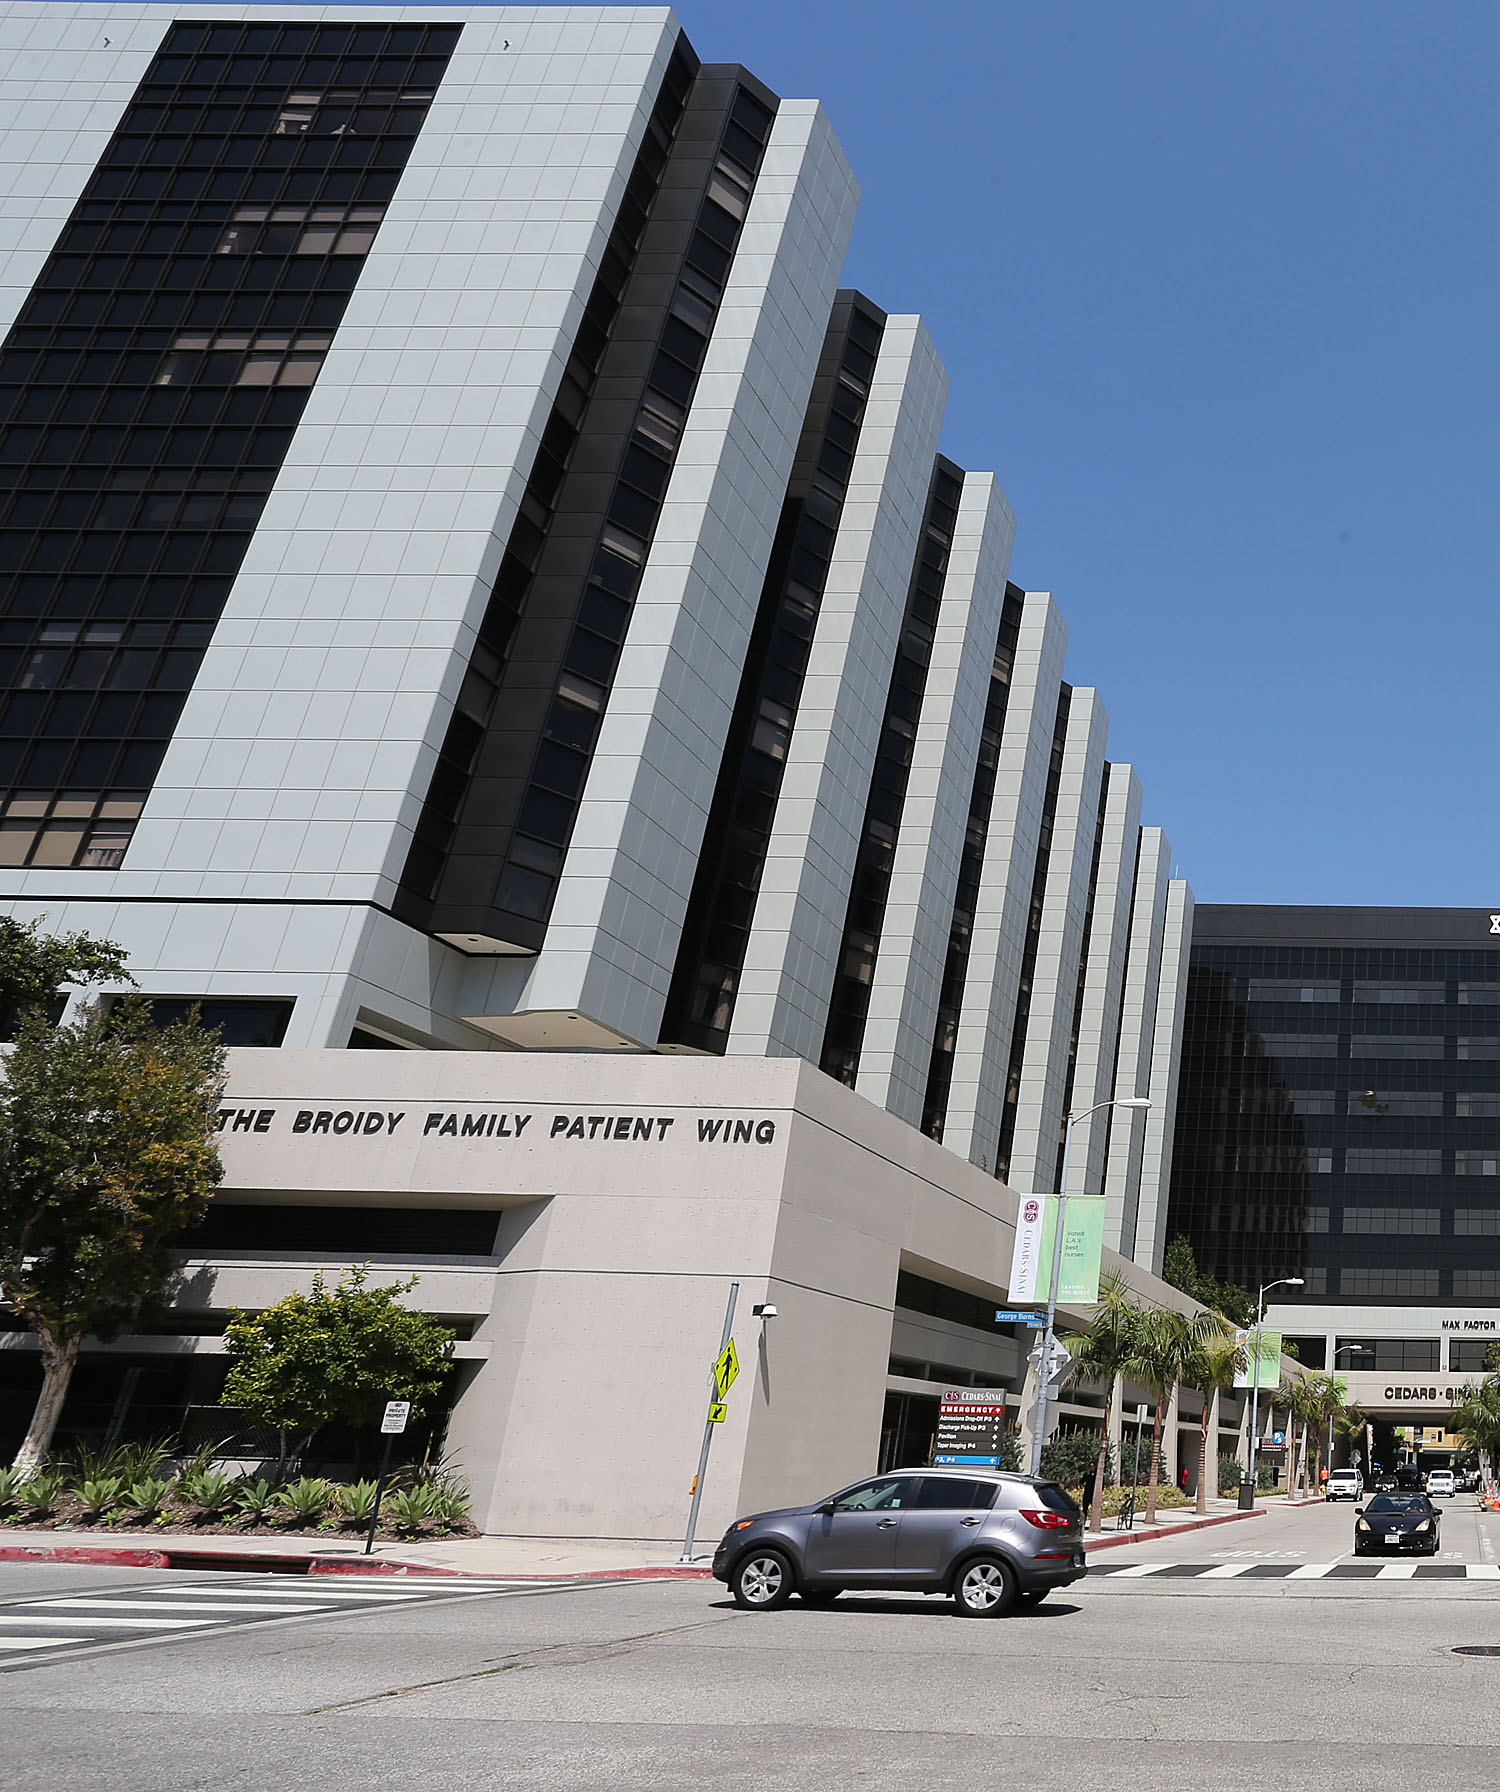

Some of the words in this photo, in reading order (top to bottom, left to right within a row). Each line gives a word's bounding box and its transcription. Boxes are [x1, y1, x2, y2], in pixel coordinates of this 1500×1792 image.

[217, 1109, 276, 1133] THE
[292, 1110, 406, 1136] BROIDY
[423, 1113, 532, 1138] FAMILY
[550, 1115, 674, 1142] PATIENT
[698, 1118, 775, 1145] WING
[997, 1312, 1018, 1321] George
[1442, 1320, 1460, 1330] MAX
[1463, 1320, 1496, 1331] FACTOR
[1384, 1386, 1437, 1401] CEDARS
